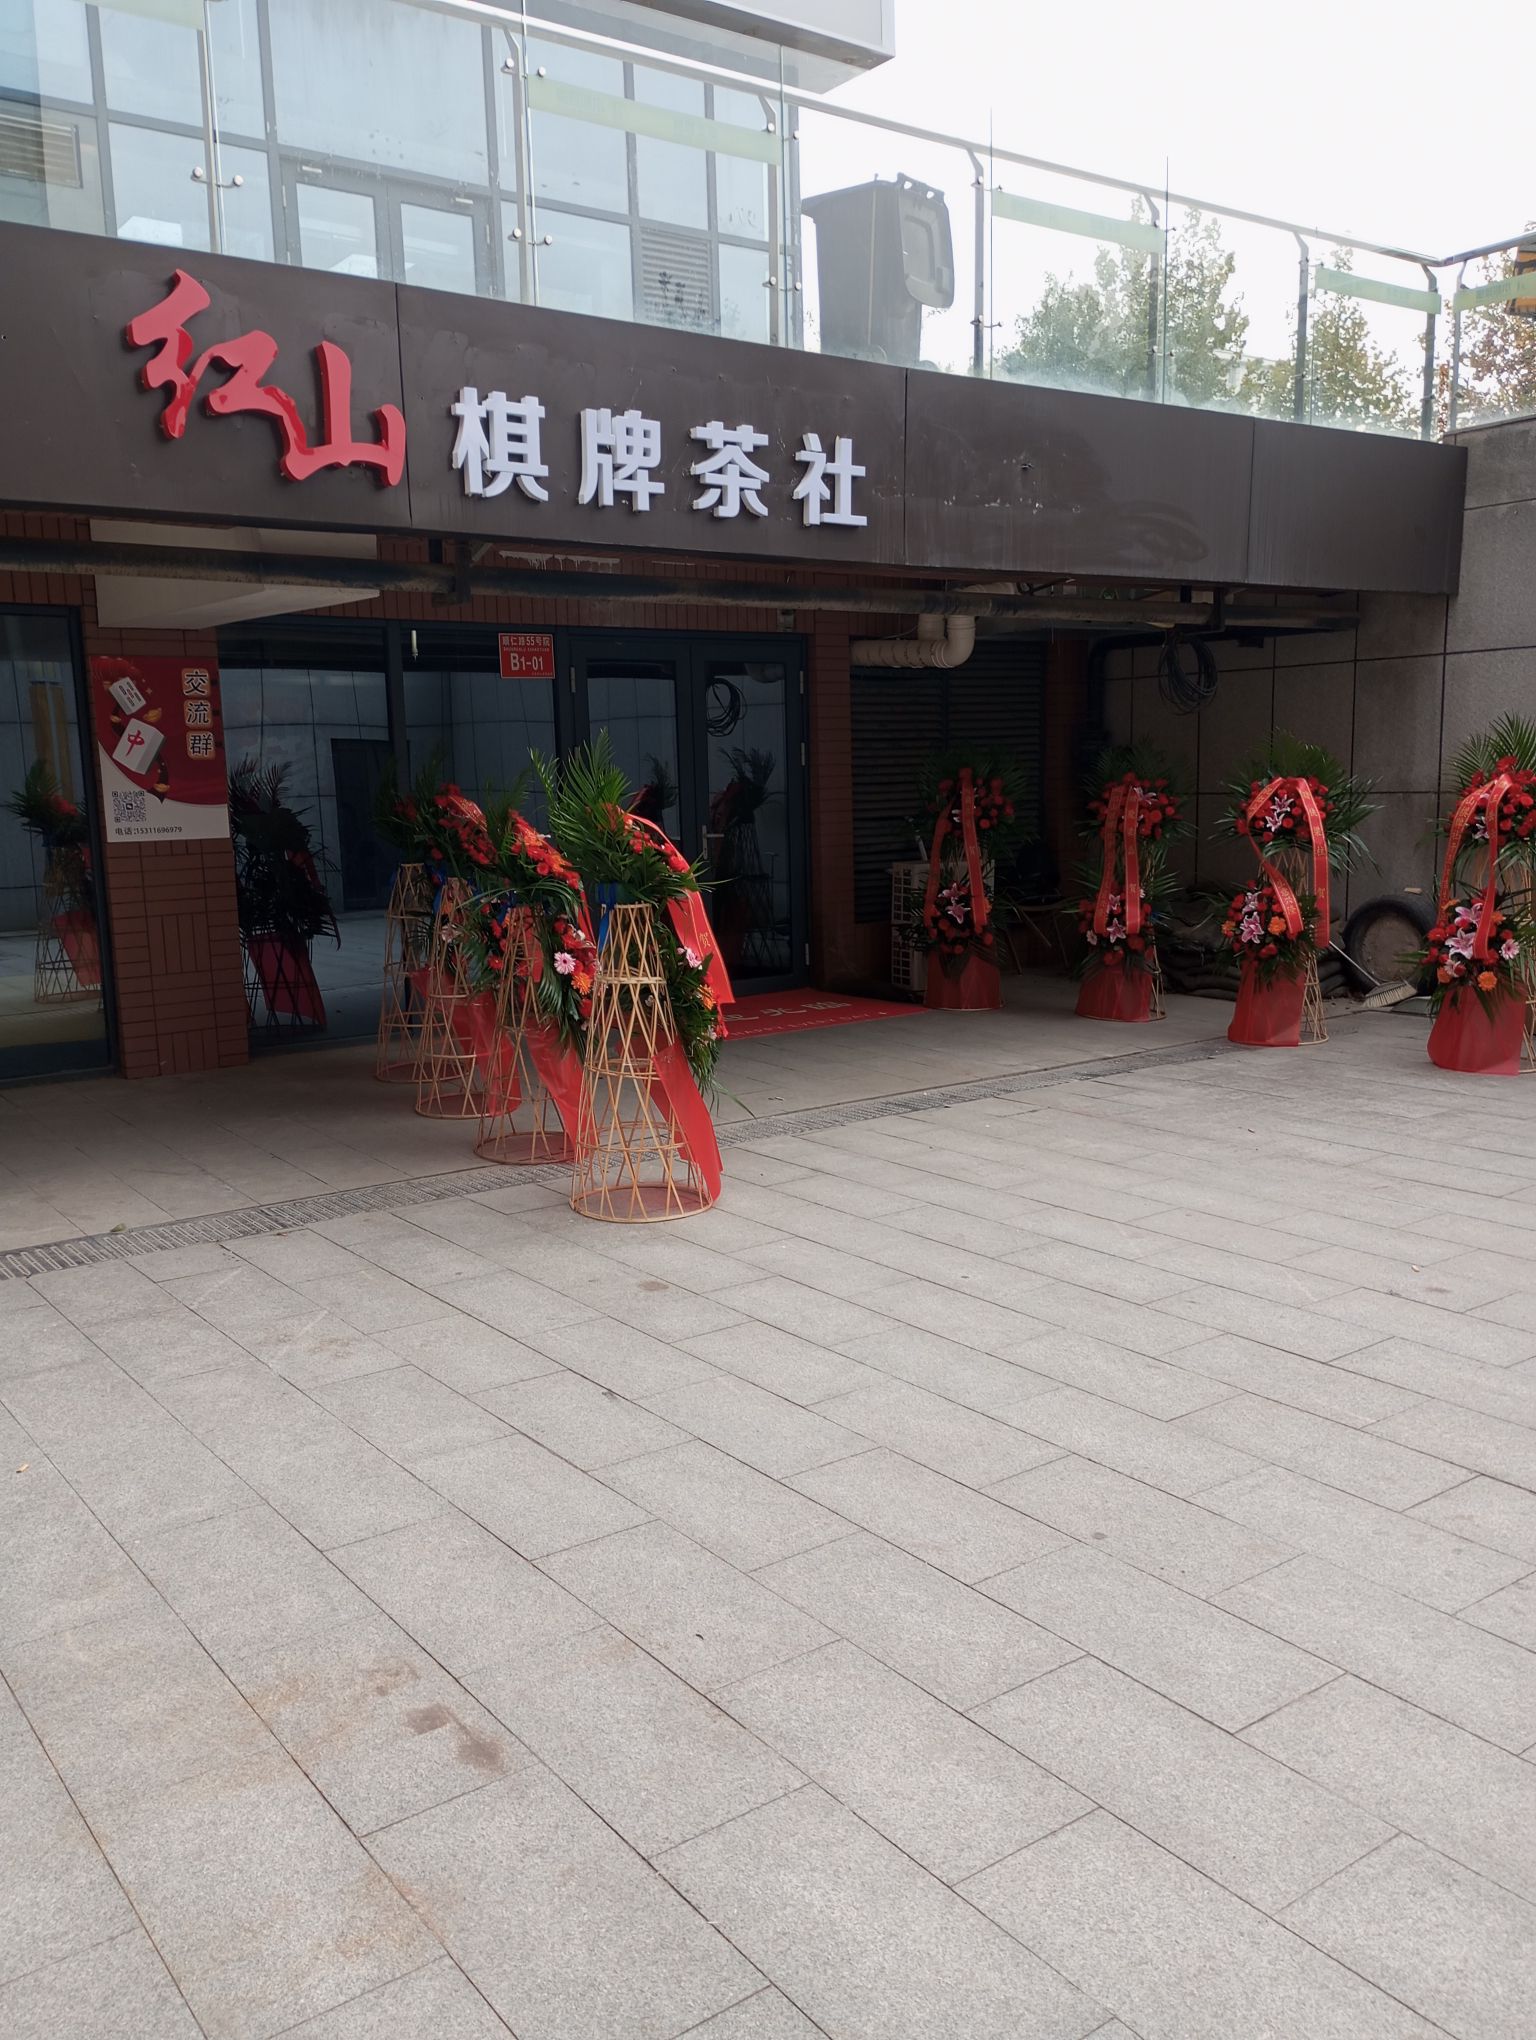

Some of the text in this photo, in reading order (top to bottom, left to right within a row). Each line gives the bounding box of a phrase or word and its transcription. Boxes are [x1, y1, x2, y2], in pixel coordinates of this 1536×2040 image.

[126, 268, 868, 527] 红山 棋牌茶社
[510, 652, 544, 671] B1-01
[184, 670, 214, 757] 交流群
[699, 932, 710, 948] 贺
